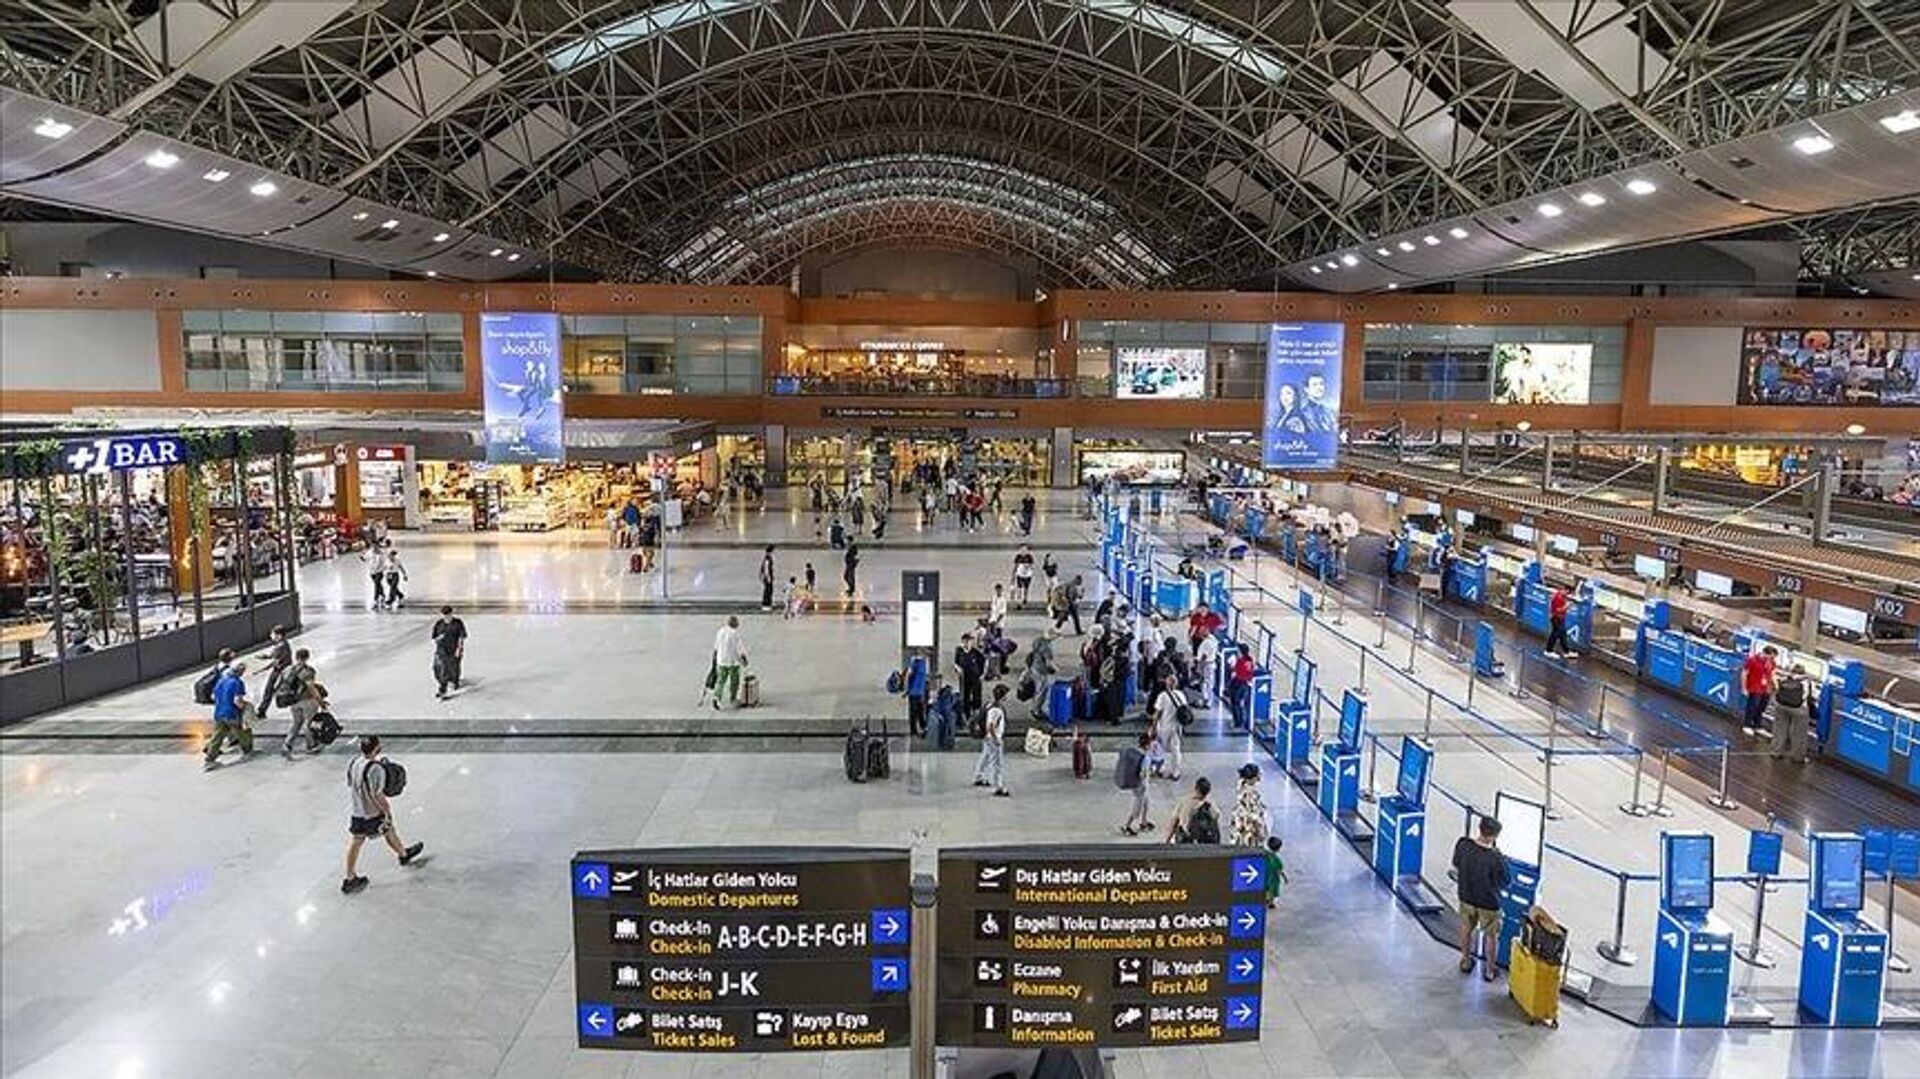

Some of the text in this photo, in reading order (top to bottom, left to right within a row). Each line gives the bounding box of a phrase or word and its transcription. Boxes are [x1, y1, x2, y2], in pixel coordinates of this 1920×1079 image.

[113, 441, 177, 466] BAR
[1776, 575, 1801, 592] K03
[1874, 597, 1904, 617] K02
[648, 869, 797, 890] İç Hatlar Giden Yolcu
[1016, 866, 1171, 887] Dış Hatlar Giden Yolcu
[649, 891, 799, 908] Domestic Departures
[1016, 887, 1187, 904] International Departures
[651, 919, 712, 936] Check-in
[1014, 912, 1227, 934] Engelli Yolcu Danışma & Check-in
[717, 923, 867, 949] A-B-C-D-E-F-G-H
[1014, 932, 1223, 950] Disabled Information & Check-in
[651, 938, 712, 955] Check-in
[651, 967, 713, 983] Check-in
[1013, 962, 1062, 978] Eczane
[1172, 958, 1220, 975] Yardım
[718, 971, 760, 997] J-K
[1013, 981, 1082, 999] Pharmacy
[1152, 979, 1208, 994] First Aid
[652, 985, 713, 1001] Check-in
[652, 1012, 722, 1031] Bilet Satış
[792, 1012, 869, 1030] Kayıp Eşya
[1012, 1008, 1073, 1026] Danışma
[1151, 1005, 1218, 1023] Bilet Satış
[652, 1031, 735, 1047] Ticket Sales
[793, 1030, 885, 1046] Lost & Found
[1013, 1026, 1094, 1042] Information
[1151, 1023, 1221, 1040] Ticket Sales
